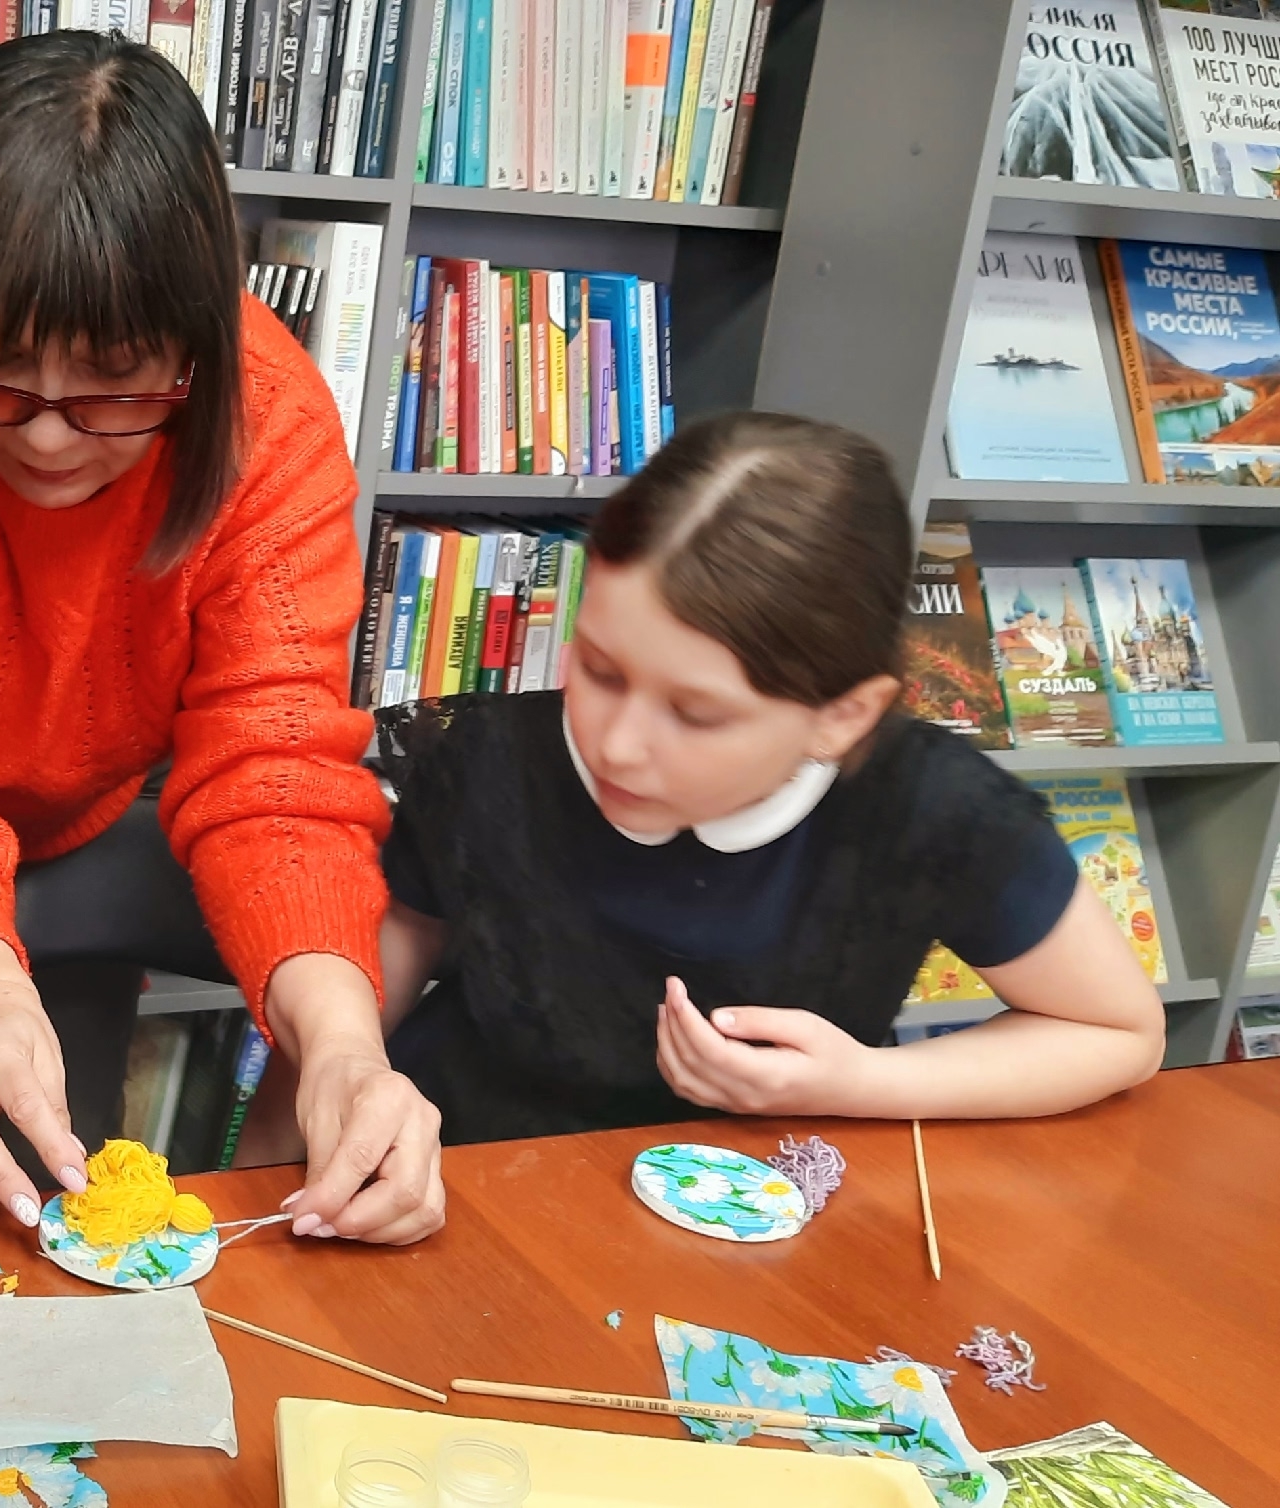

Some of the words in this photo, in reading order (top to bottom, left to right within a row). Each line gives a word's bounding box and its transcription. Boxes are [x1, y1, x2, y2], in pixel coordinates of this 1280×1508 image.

[1028, 6, 1117, 32] ЛИКАЯ
[1027, 32, 1136, 68] ОССИЯ
[1182, 25, 1217, 52] 100
[281, 36, 299, 83] ЛЕВ
[1193, 57, 1242, 85] МЕСТ
[447, 69, 460, 108] СПОК
[1148, 246, 1226, 272] САМЫЕ
[1144, 267, 1259, 296] КРАСИВЫЕ
[1172, 291, 1245, 316] МЕСТА
[1145, 311, 1239, 341] РОССИИ,
[399, 595, 412, 605] Я
[362, 586, 381, 664] СОЛОВКИ
[391, 614, 410, 668] ЖЕНЩИНА
[448, 615, 469, 669] АЛХИМИЯ
[1018, 677, 1098, 695] СУЗДАЛЬ
